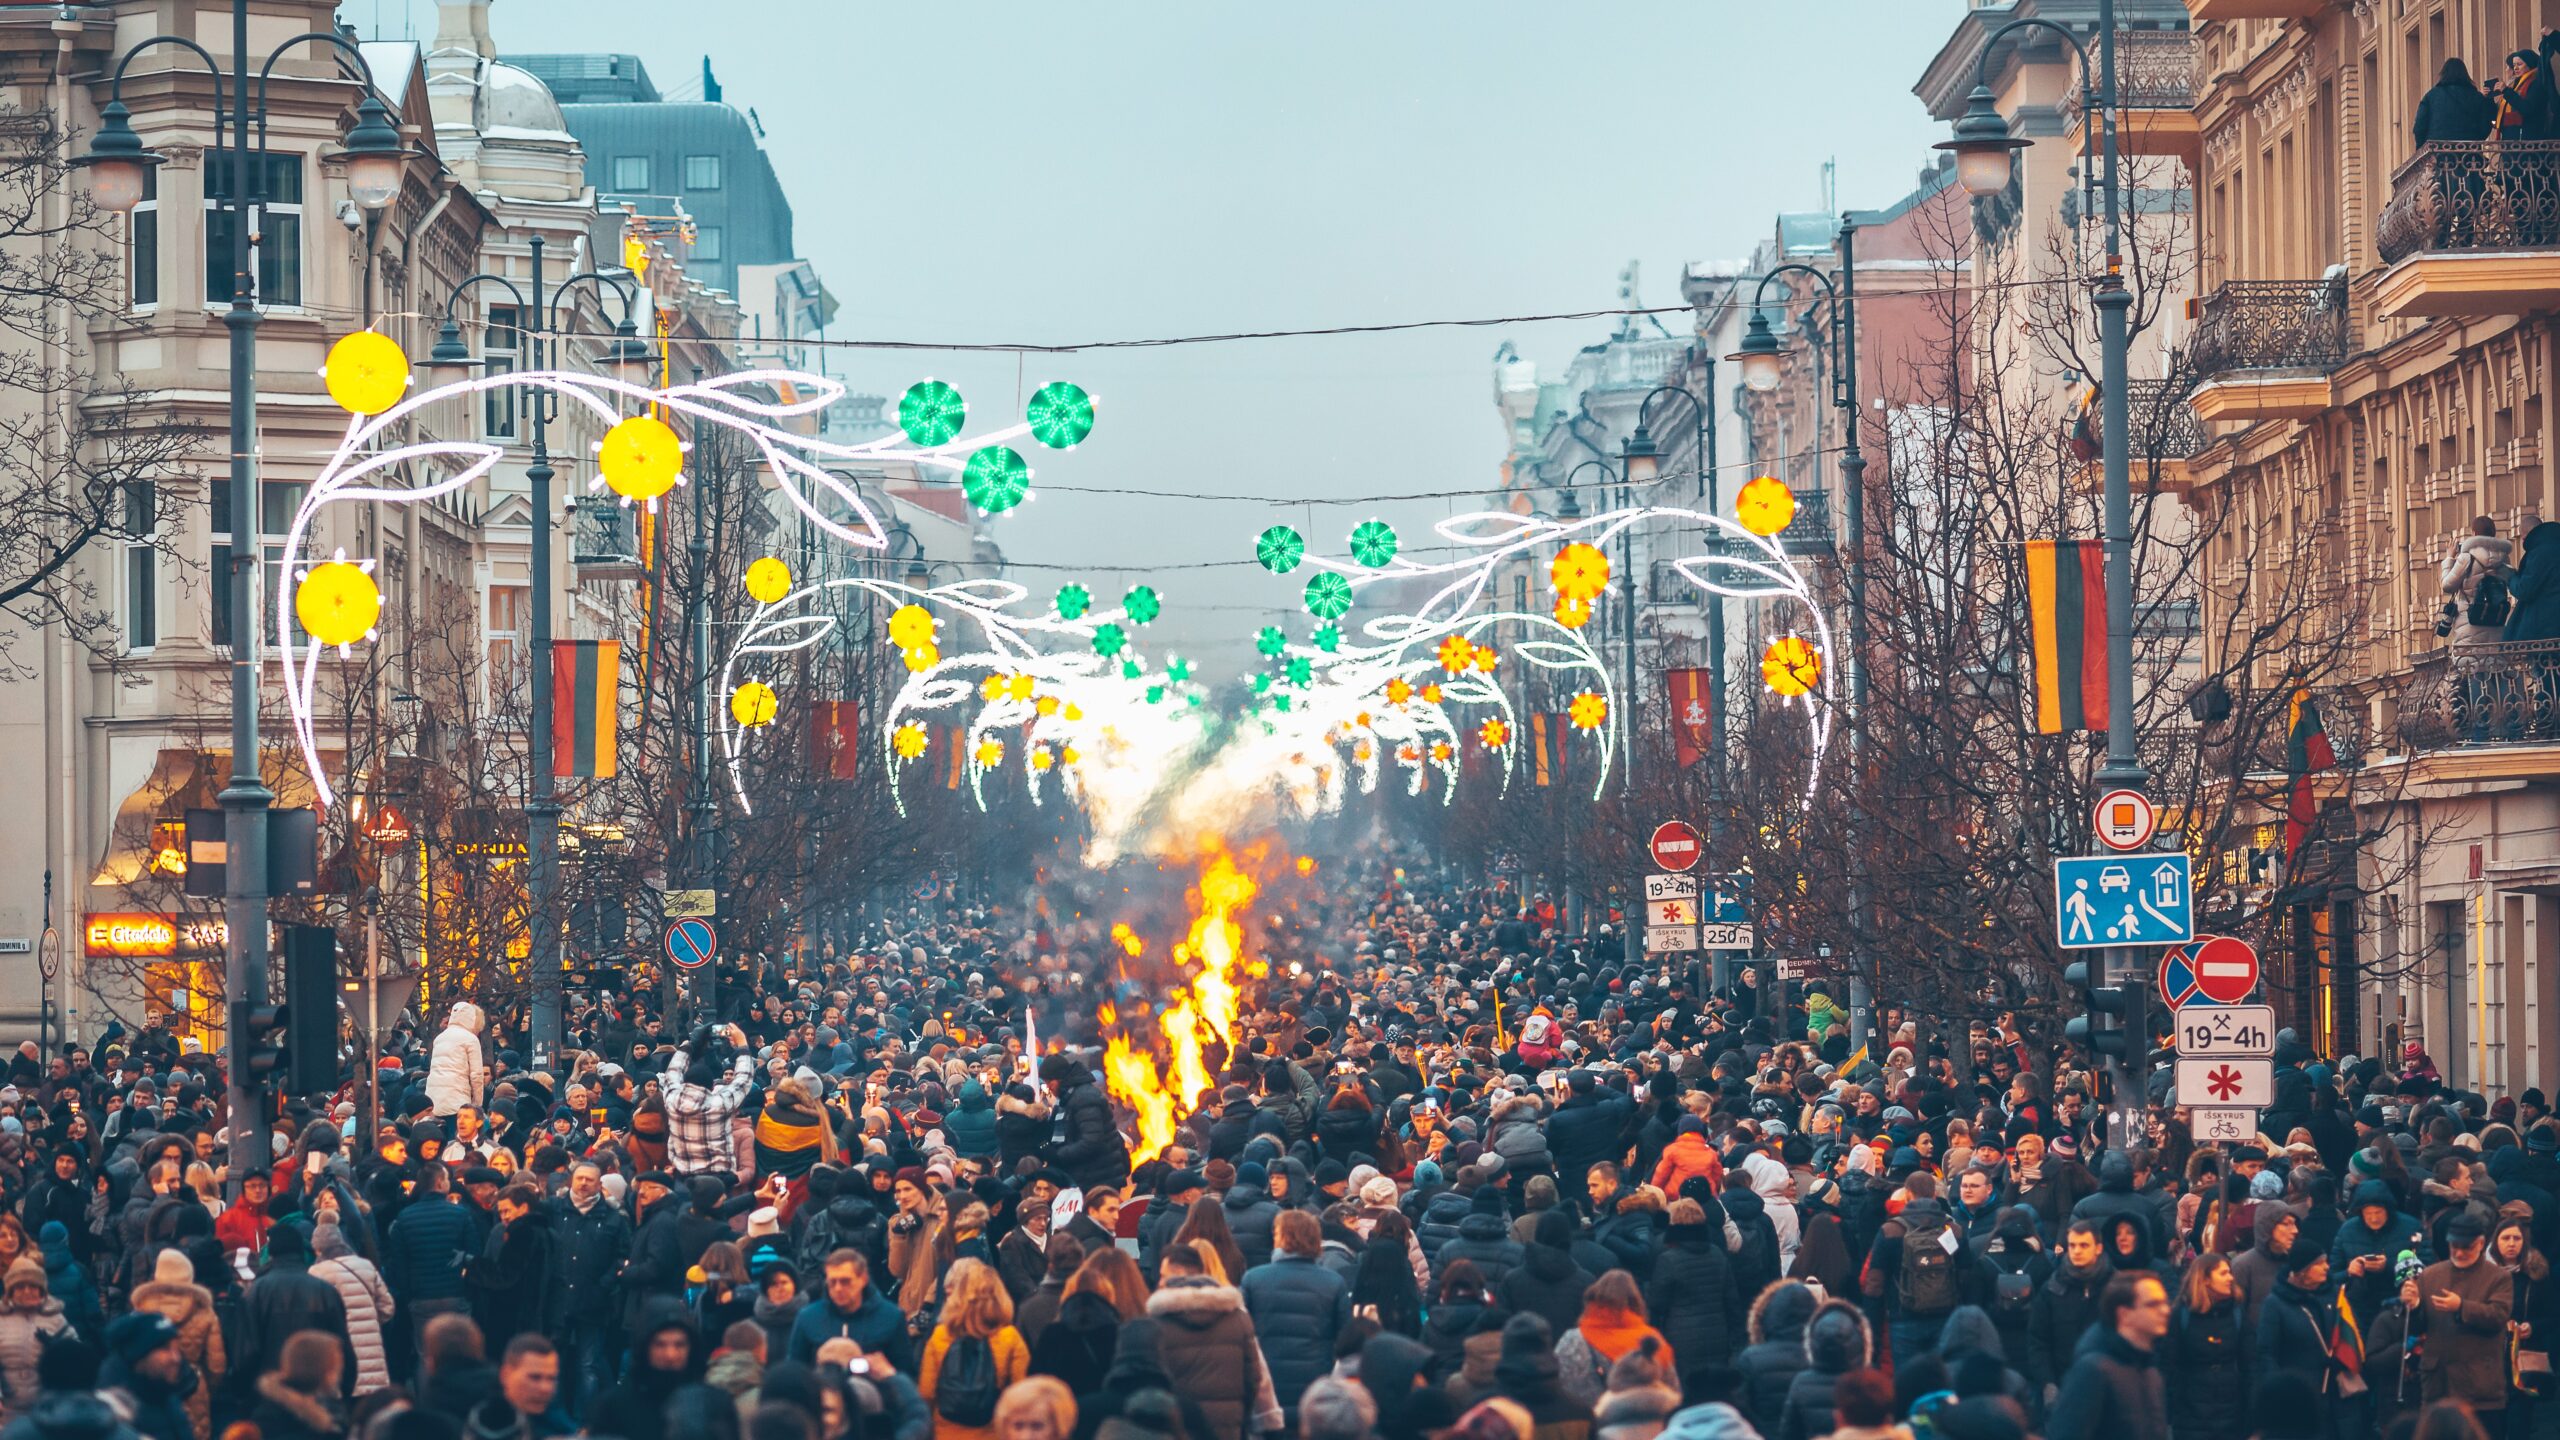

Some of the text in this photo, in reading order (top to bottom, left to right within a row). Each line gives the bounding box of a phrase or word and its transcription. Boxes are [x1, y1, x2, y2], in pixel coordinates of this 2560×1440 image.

[1708, 930, 1750, 944] 250 m
[2204, 1111, 2245, 1119] IŠSKYRUS
